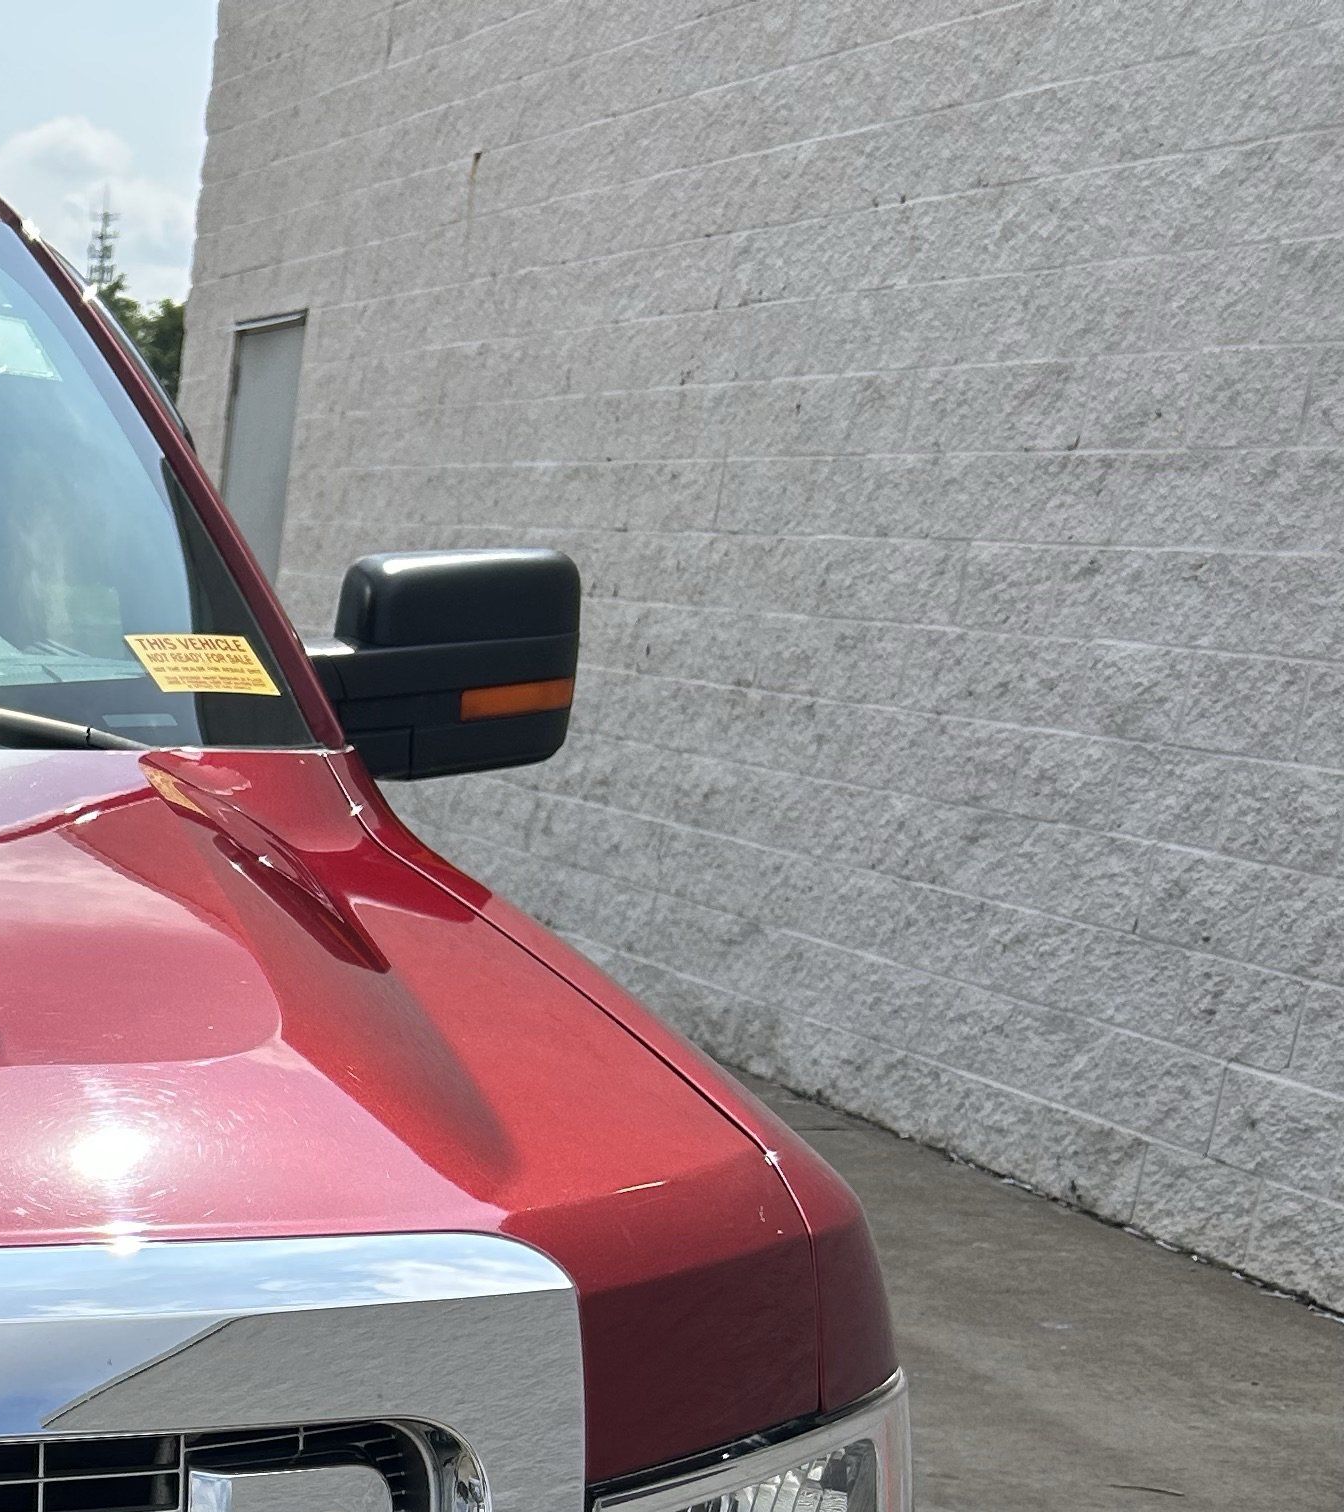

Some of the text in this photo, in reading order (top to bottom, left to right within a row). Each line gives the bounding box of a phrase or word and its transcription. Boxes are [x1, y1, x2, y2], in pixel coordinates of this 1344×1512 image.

[135, 637, 247, 653] THIS VEHICLE
[146, 652, 255, 666] NOT READY FOR SALE
